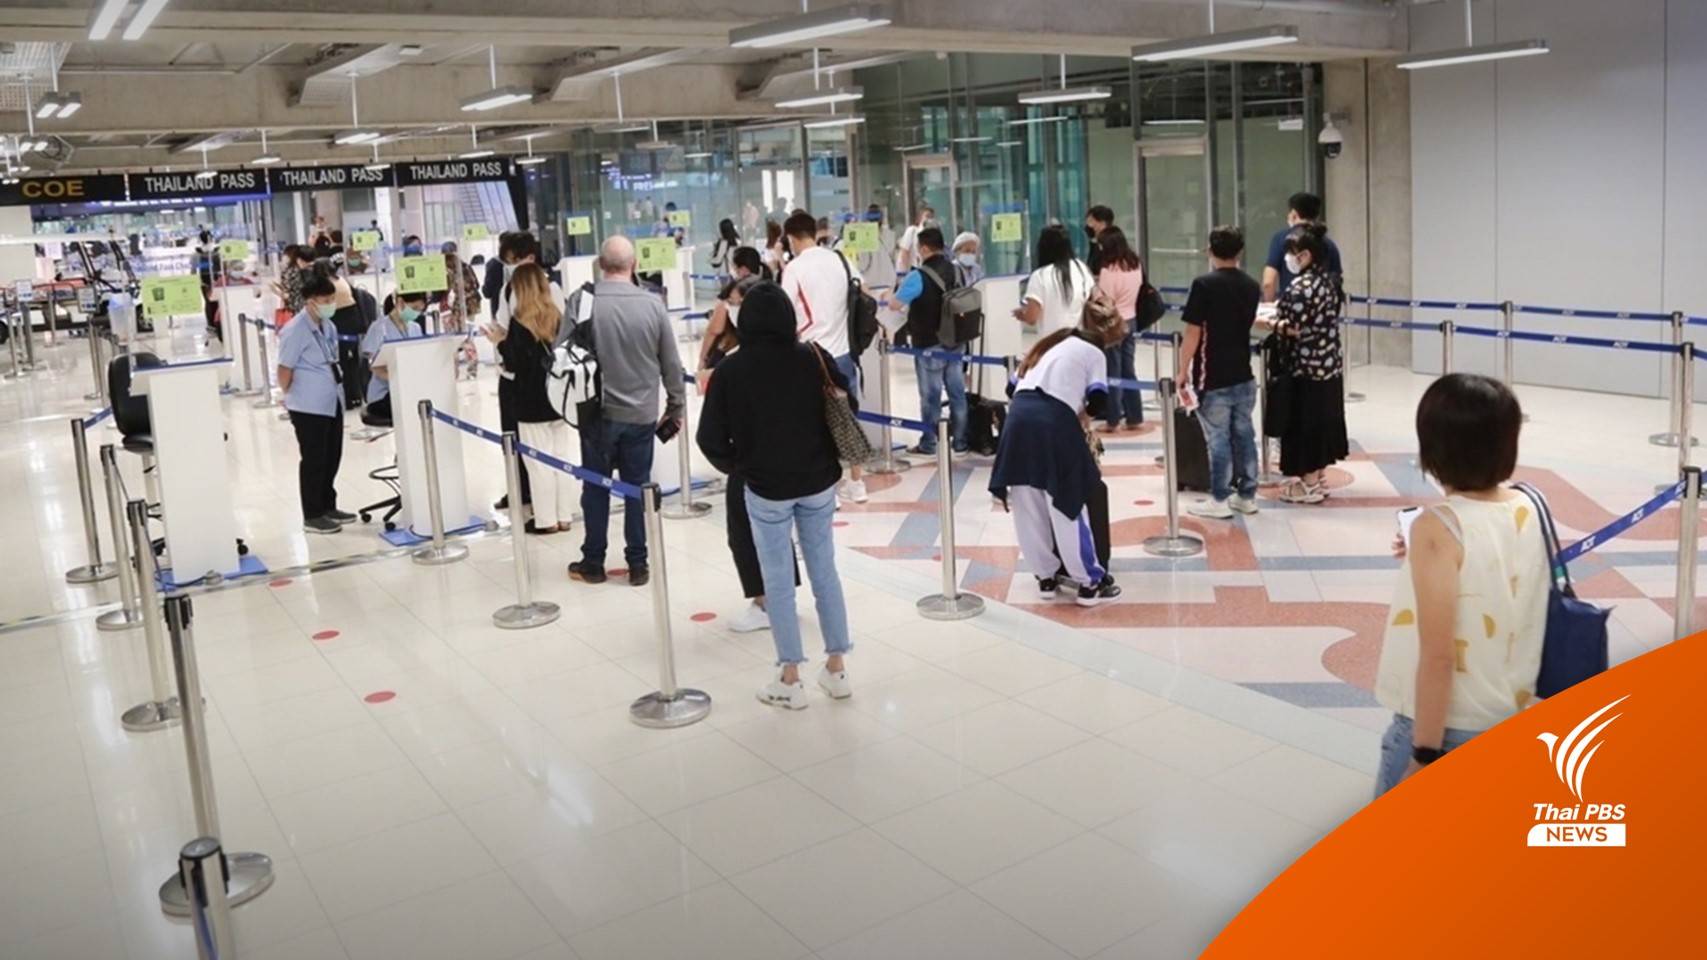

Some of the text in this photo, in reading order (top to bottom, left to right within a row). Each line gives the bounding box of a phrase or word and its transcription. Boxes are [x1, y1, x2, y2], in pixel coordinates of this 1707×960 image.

[282, 167, 383, 186] THAILAND PASS
[409, 162, 502, 182] THAILAND PASS
[22, 180, 85, 198] COE
[144, 172, 256, 193] THAILAND PASS
